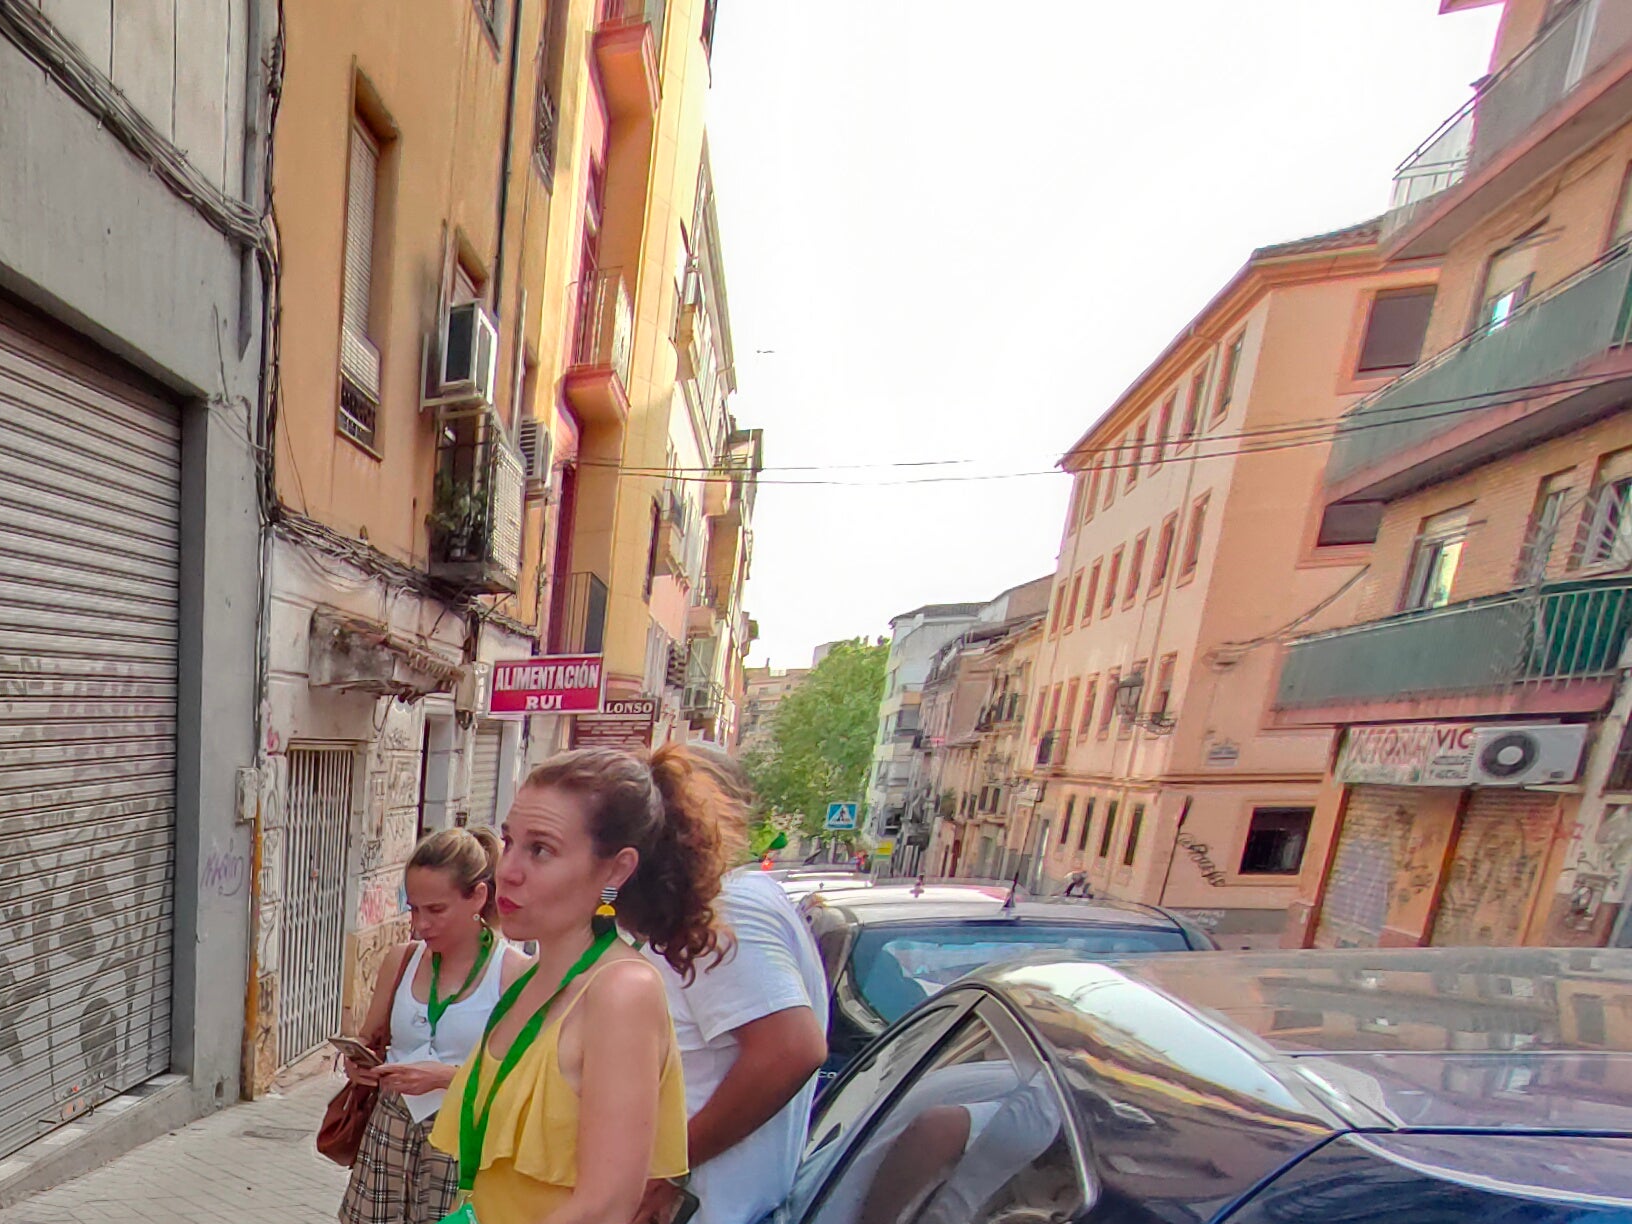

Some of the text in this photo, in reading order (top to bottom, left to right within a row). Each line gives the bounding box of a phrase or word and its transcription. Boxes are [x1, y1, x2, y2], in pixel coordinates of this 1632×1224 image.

[495, 660, 600, 691] ALIMENTACIÓN
[525, 695, 563, 710] RUI
[606, 702, 653, 714] LONSO
